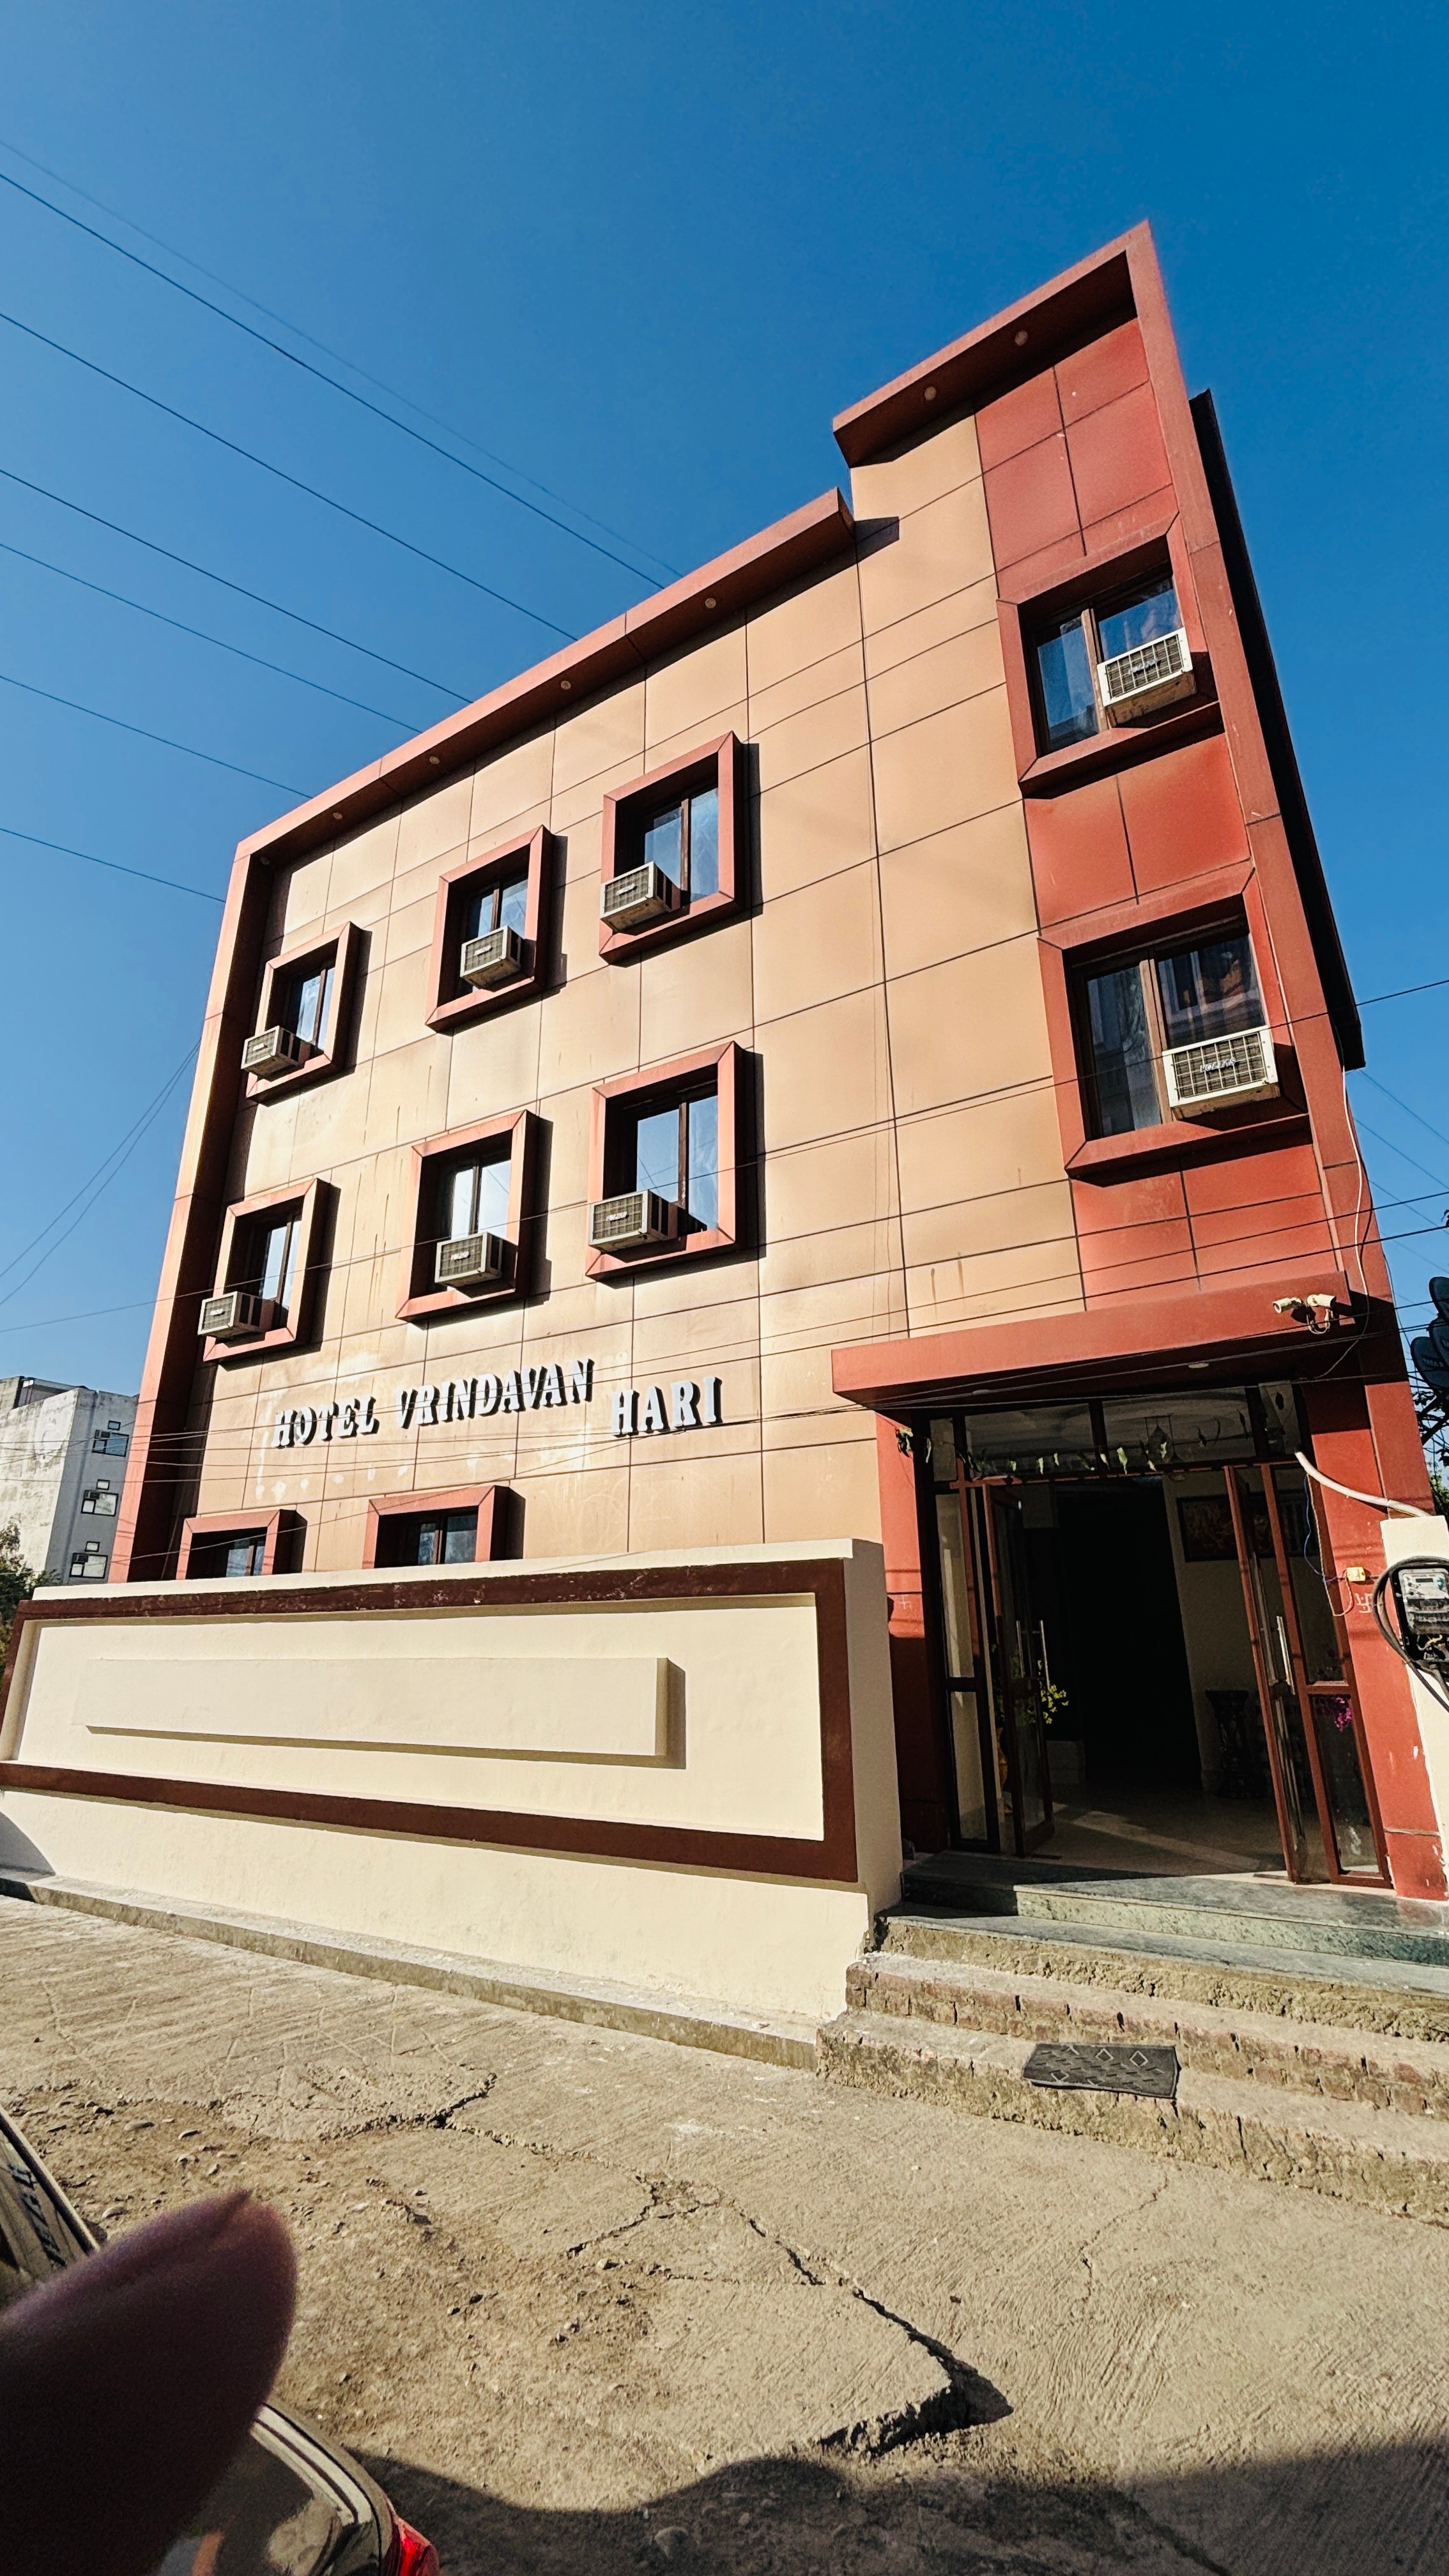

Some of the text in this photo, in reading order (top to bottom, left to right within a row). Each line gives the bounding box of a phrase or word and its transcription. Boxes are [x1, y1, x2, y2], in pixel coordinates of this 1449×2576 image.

[272, 1359, 719, 1448] HOTEL VRINDAVAN HARI
